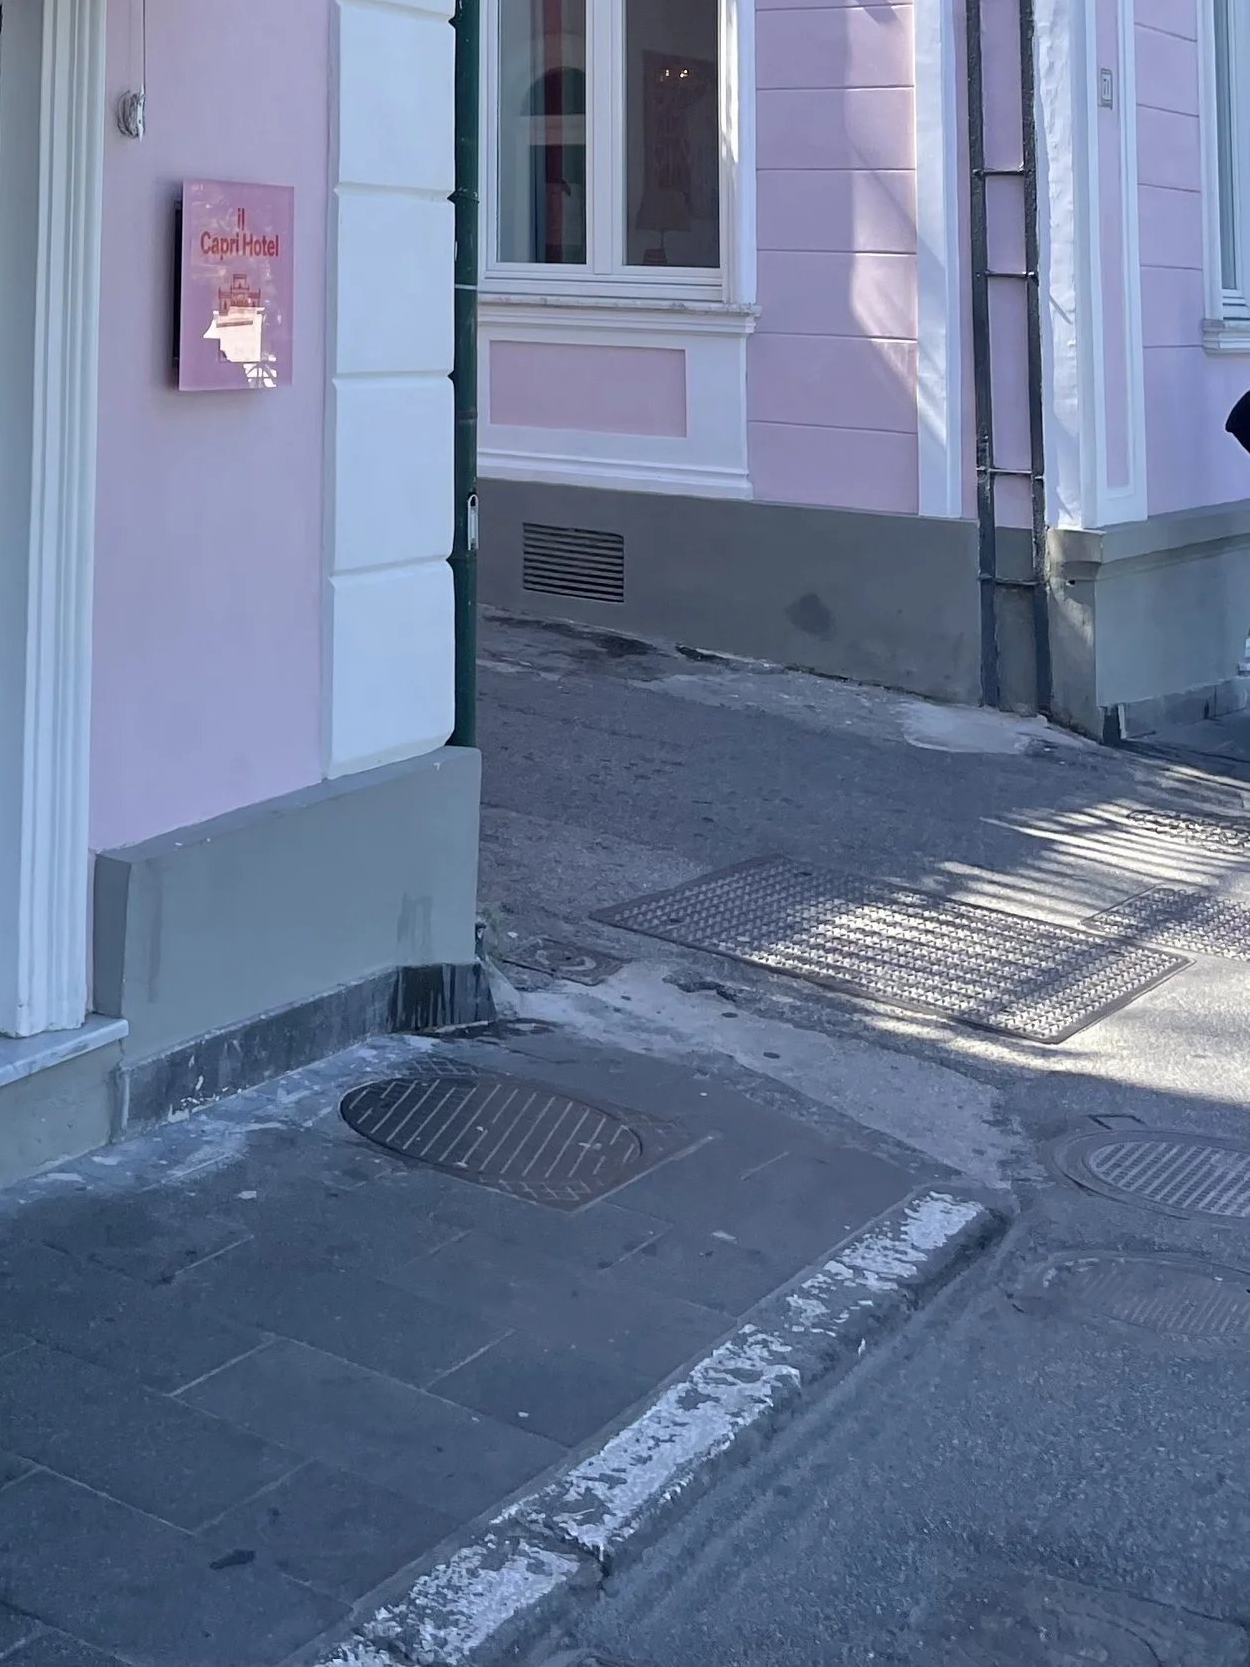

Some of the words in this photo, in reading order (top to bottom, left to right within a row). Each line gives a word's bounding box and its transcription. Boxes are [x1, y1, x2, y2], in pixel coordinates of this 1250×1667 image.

[237, 207, 245, 231] il
[200, 231, 239, 261] Capri
[242, 233, 279, 257] Hotel
